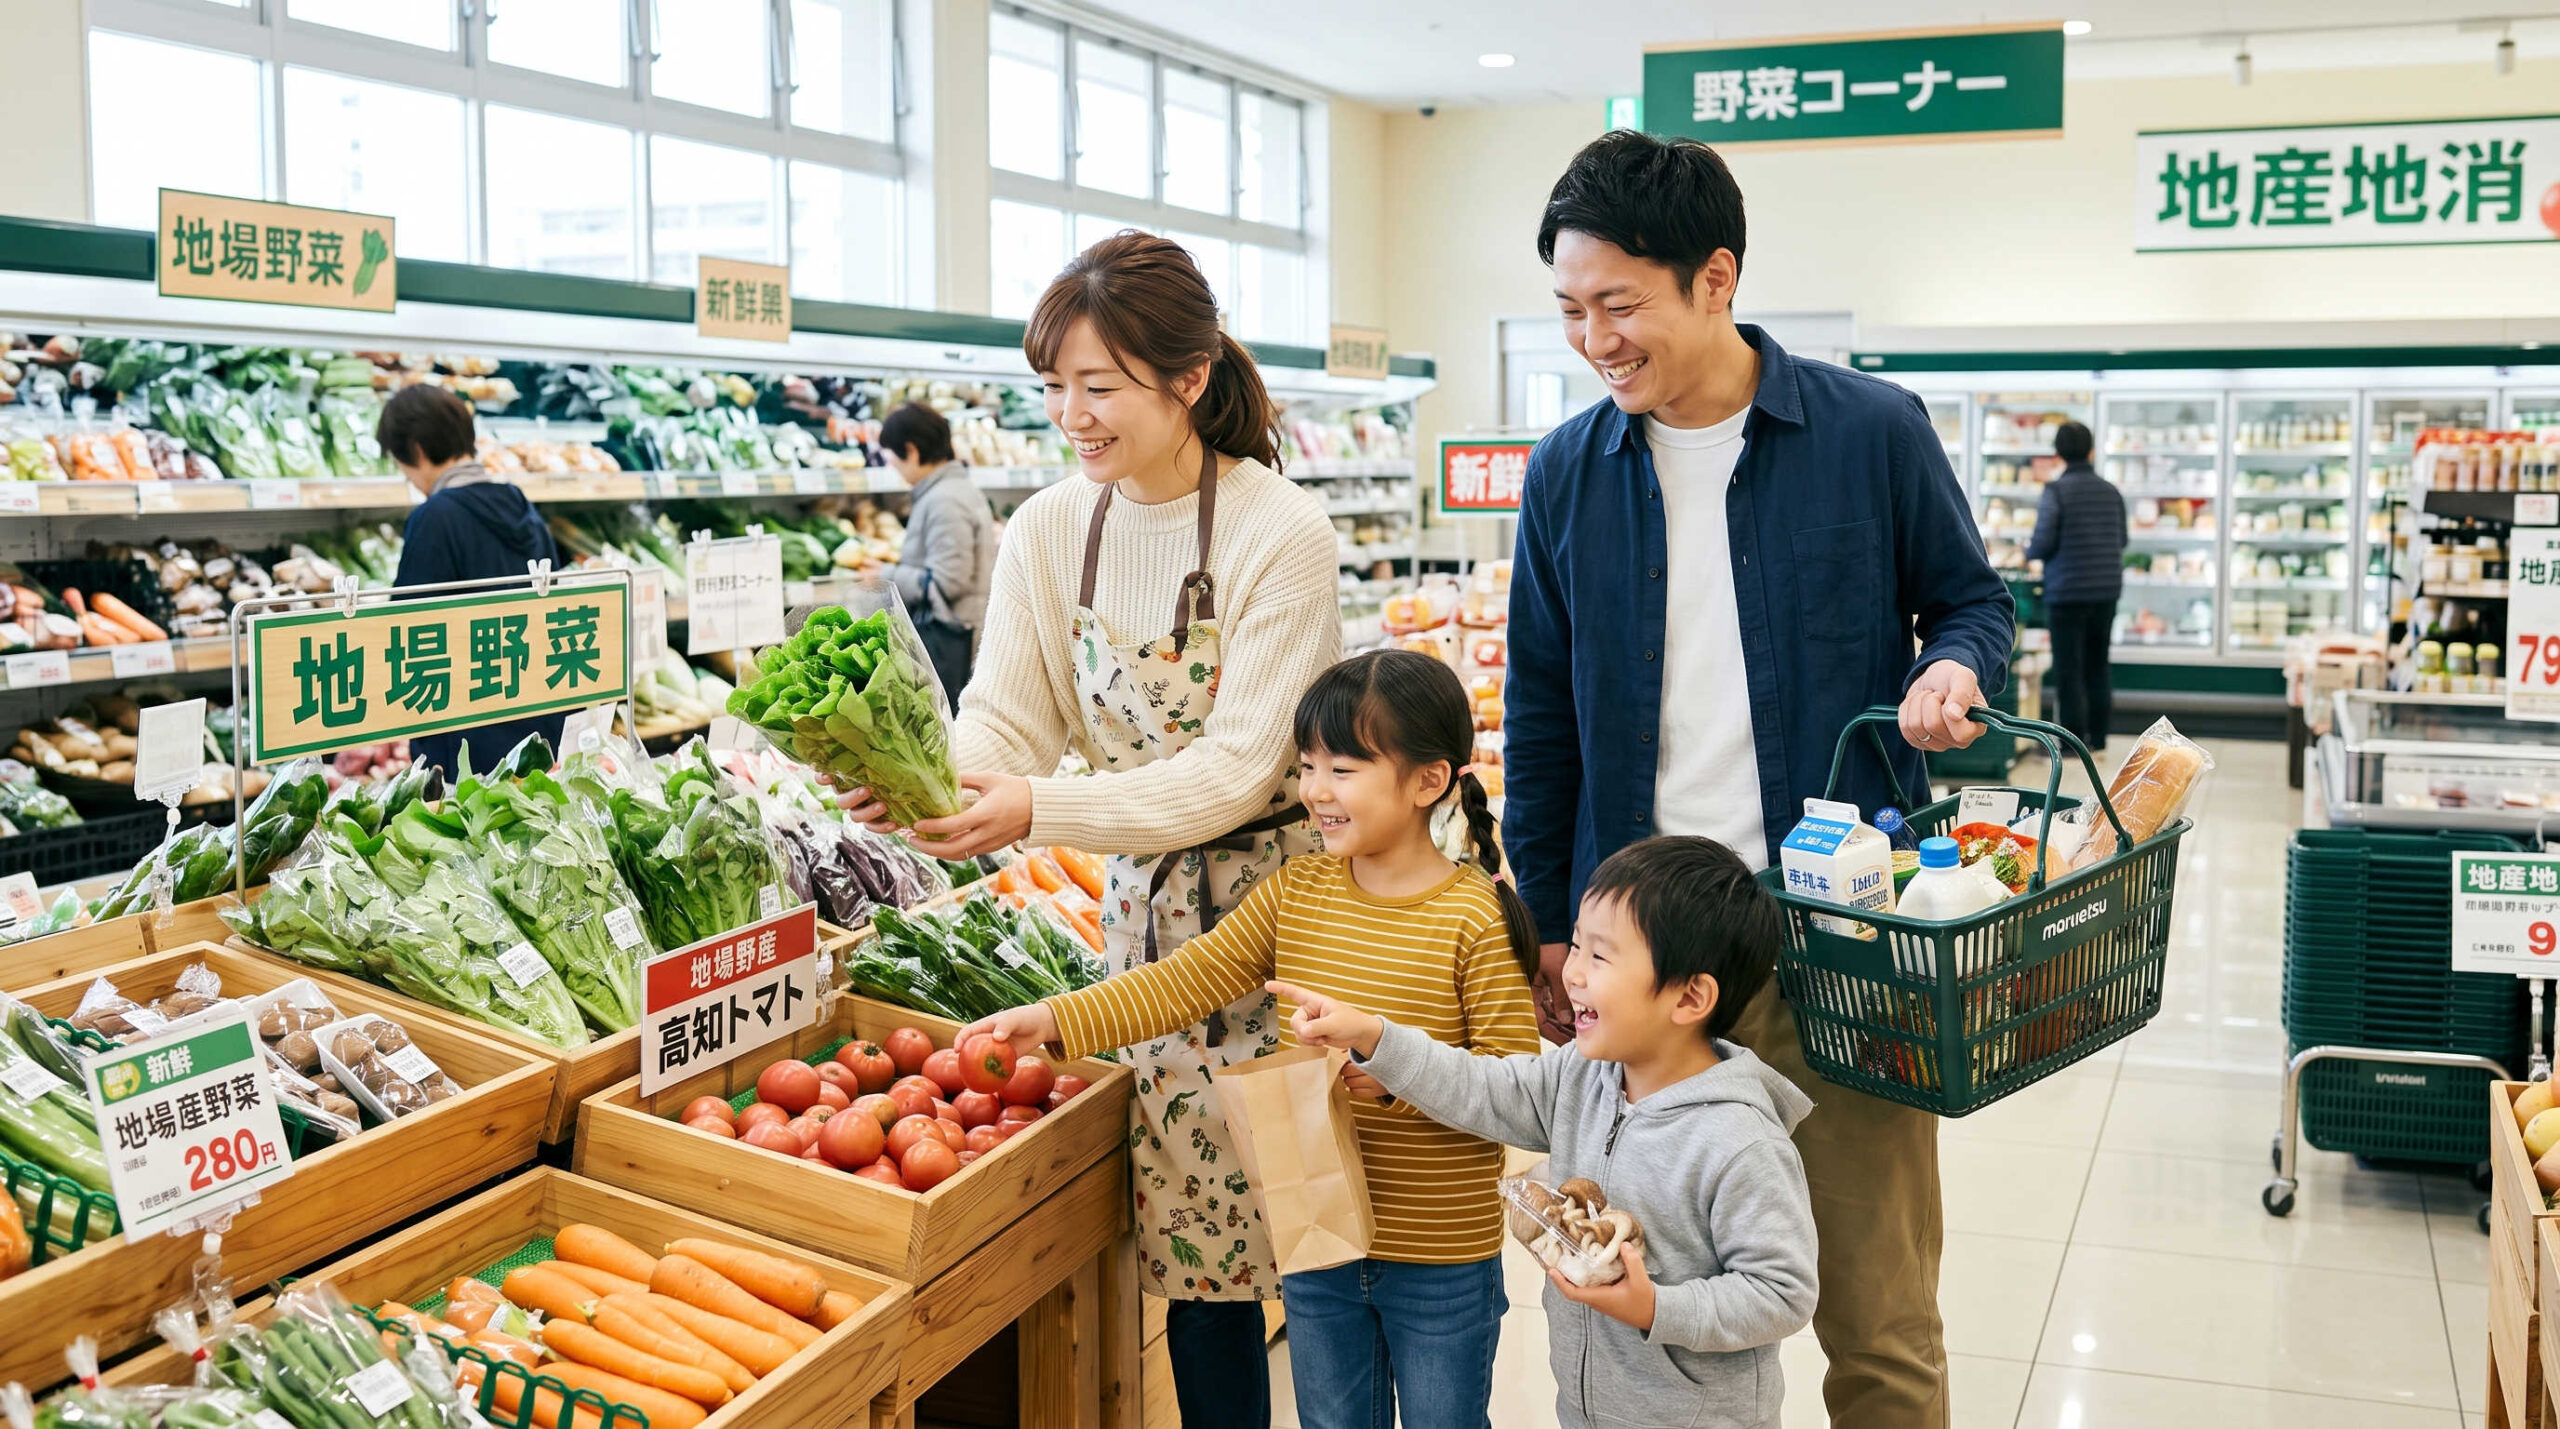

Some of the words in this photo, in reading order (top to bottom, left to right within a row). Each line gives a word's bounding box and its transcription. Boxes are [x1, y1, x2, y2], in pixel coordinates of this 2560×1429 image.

[1692, 60, 2007, 123] 野菜コーナー
[2157, 140, 2528, 228] 地産地消
[172, 215, 344, 287] 地場野菜
[292, 604, 601, 729] 地場野菜
[690, 930, 777, 989] 地場野産
[2527, 921, 2558, 956] 9
[658, 973, 804, 1076] 高知トマト
[145, 1045, 194, 1085] 新鮮
[115, 1072, 261, 1151] 地場産野菜
